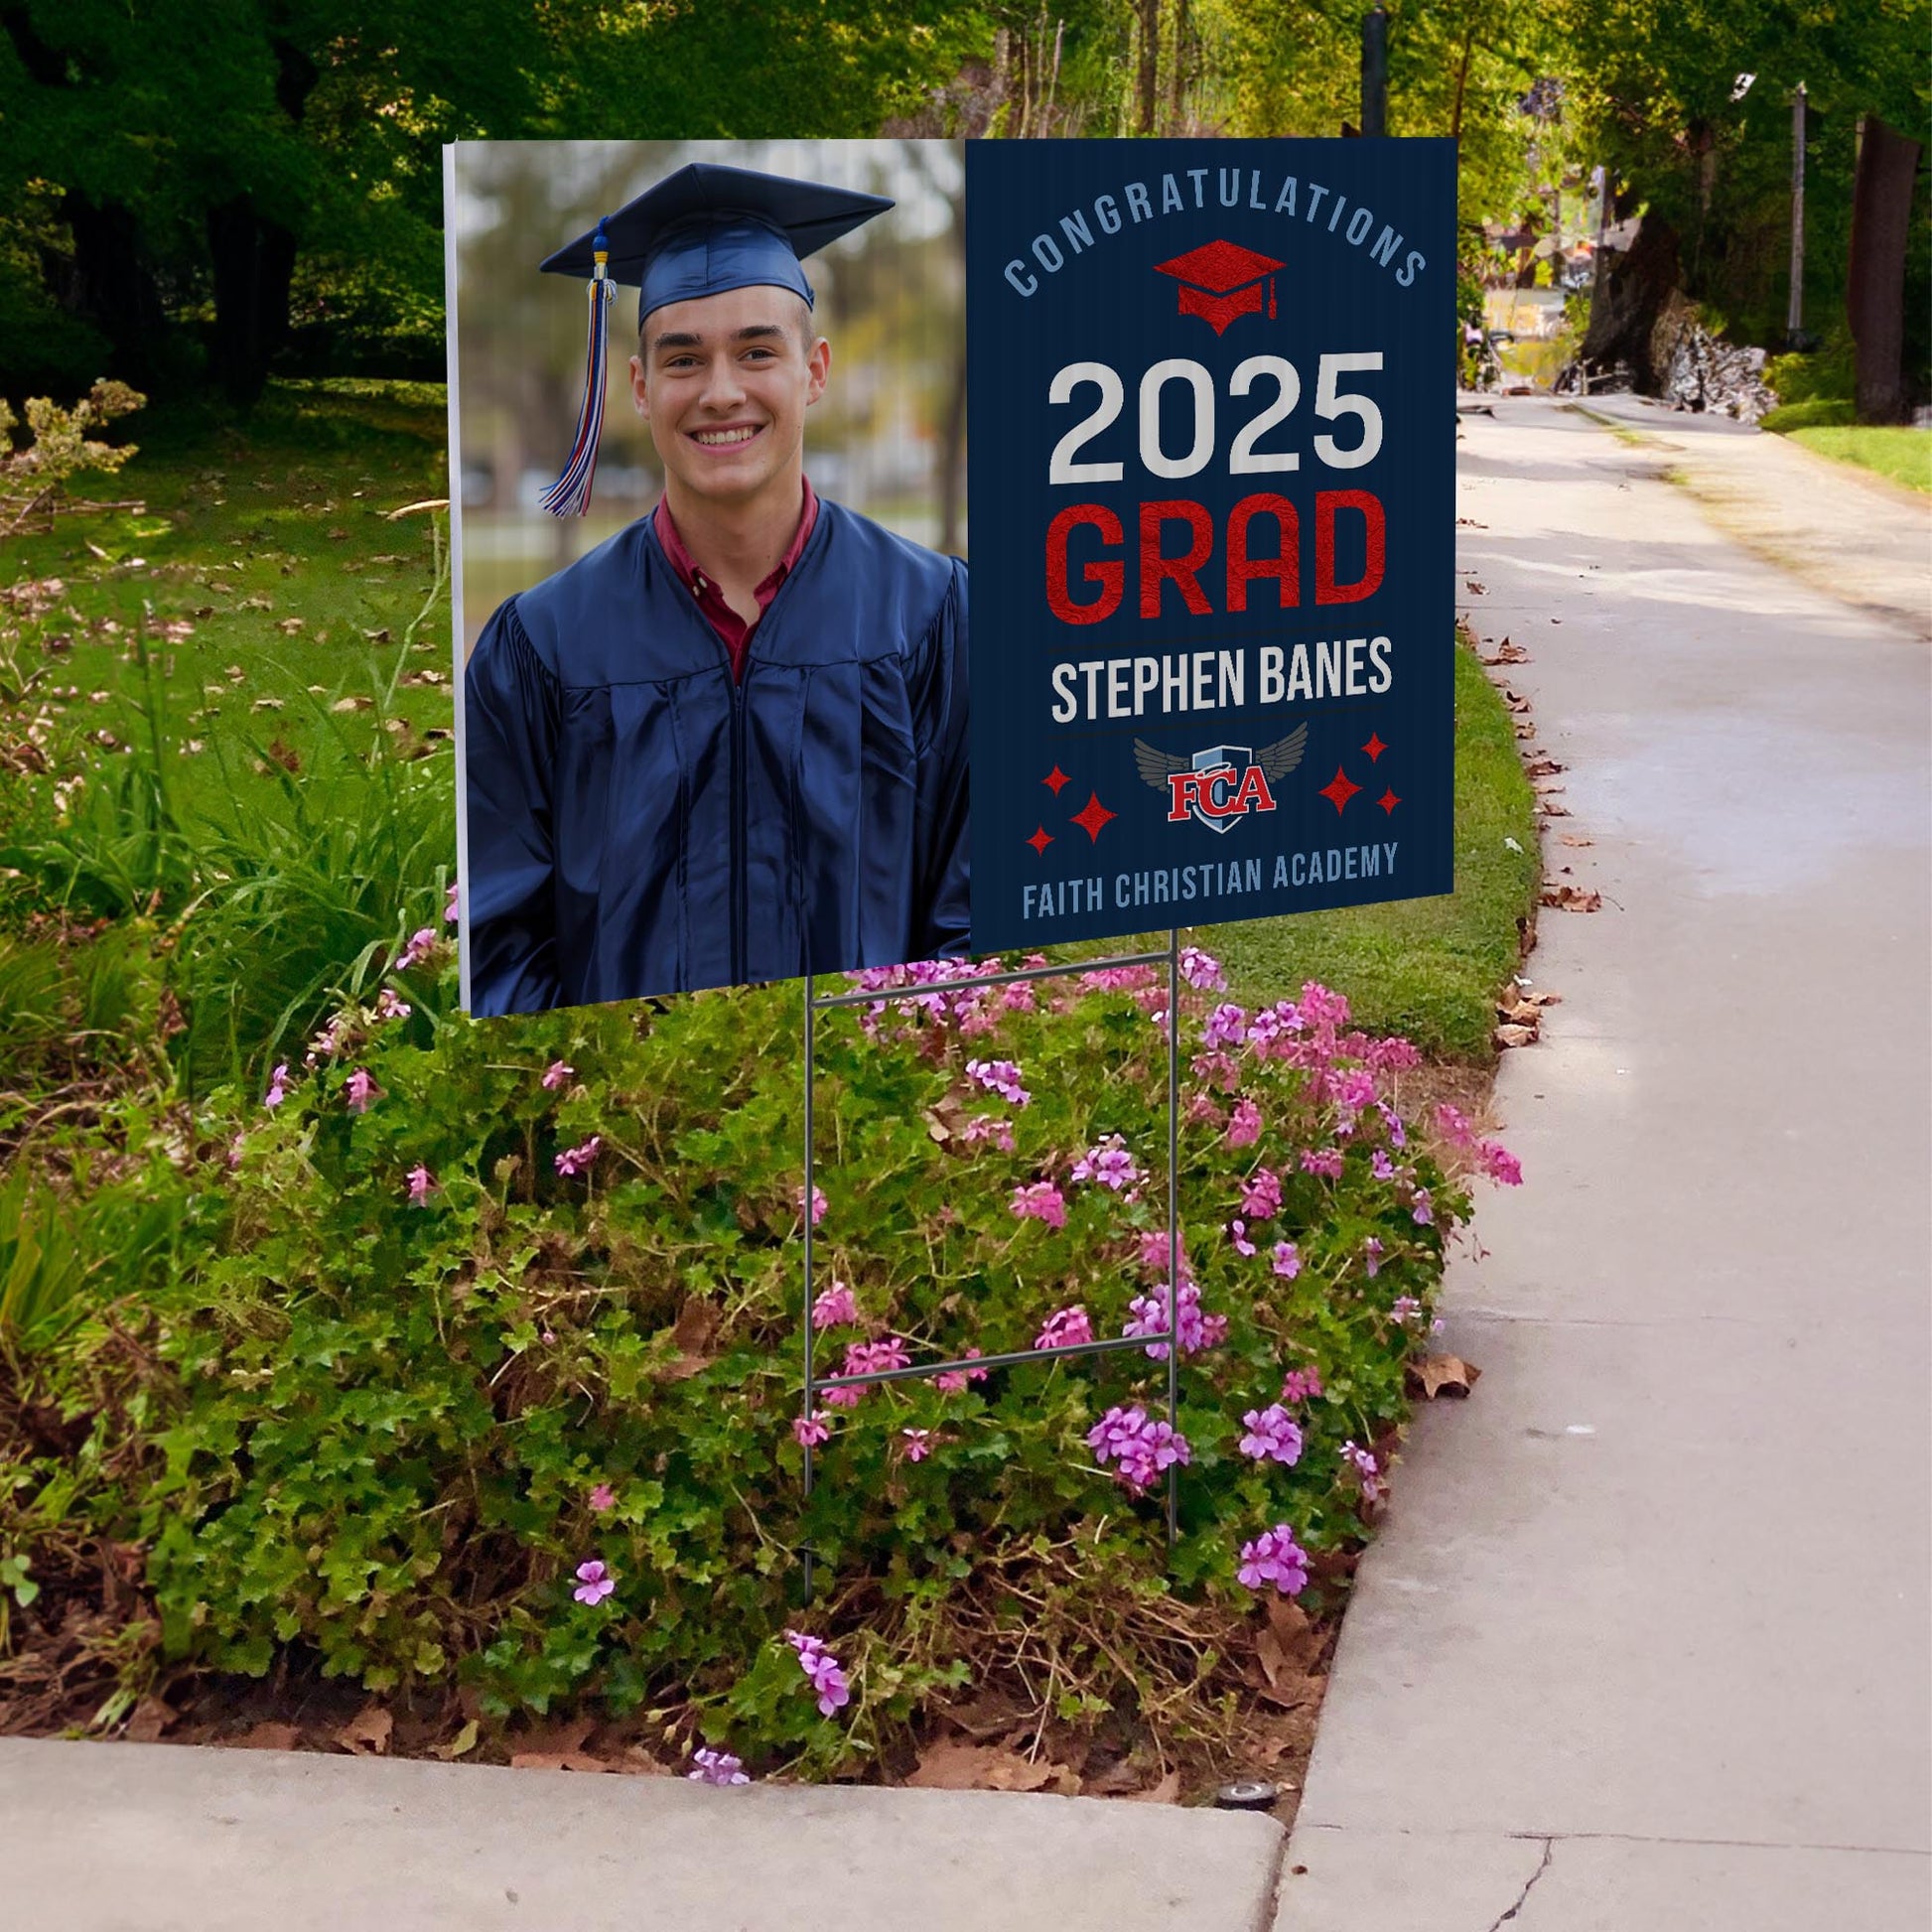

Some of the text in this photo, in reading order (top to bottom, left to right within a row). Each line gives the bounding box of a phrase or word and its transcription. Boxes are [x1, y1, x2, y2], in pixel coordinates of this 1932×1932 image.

[1004, 167, 1427, 298] CONGRATULATIONS
[1048, 351, 1384, 485] 2025
[1044, 488, 1386, 626] GRAD
[1050, 635, 1393, 724] STEPHEN BANES
[1168, 765, 1277, 823] FCA
[1023, 842, 1399, 919] FAITH CHRISTIAN ACADEMY
